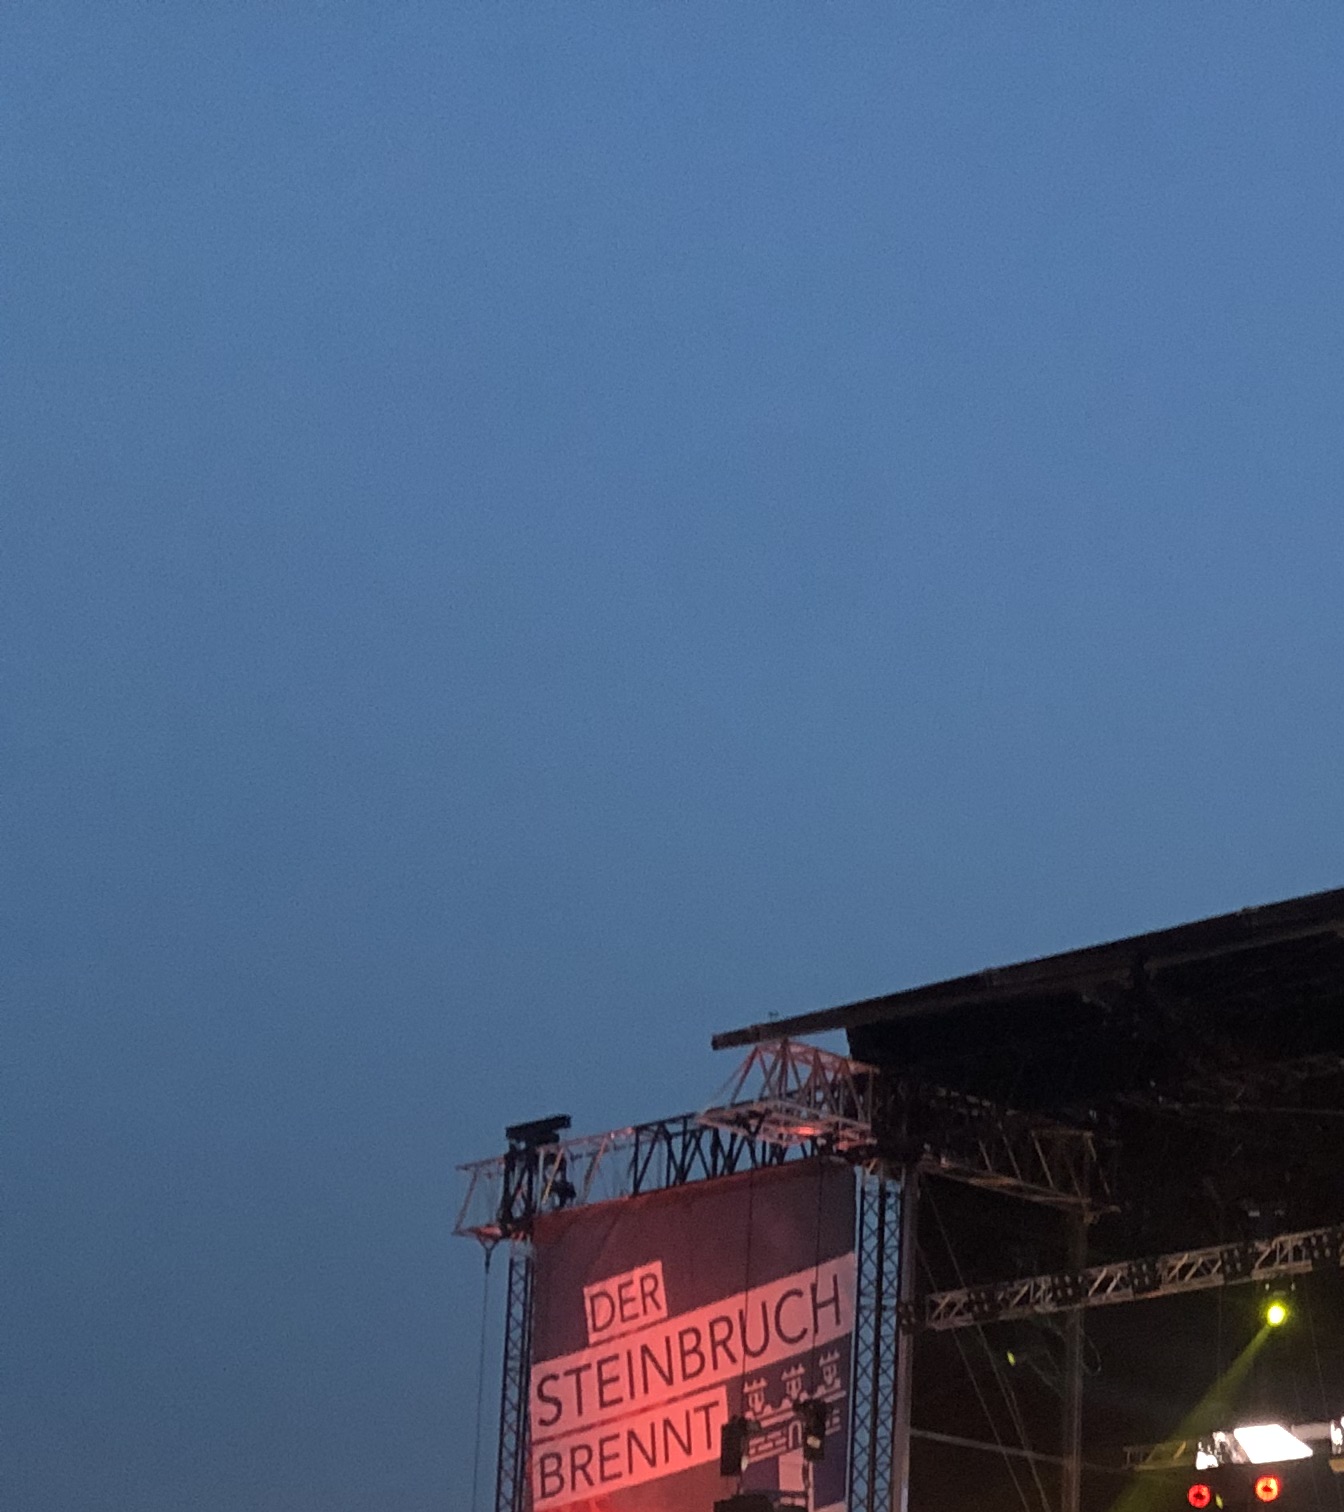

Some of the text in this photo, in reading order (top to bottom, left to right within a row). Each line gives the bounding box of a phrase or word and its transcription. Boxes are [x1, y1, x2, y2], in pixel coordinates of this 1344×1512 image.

[536, 1274, 842, 1428] STEINBRUCH
[588, 1272, 663, 1334] DER
[538, 1400, 720, 1500] BRENNT
